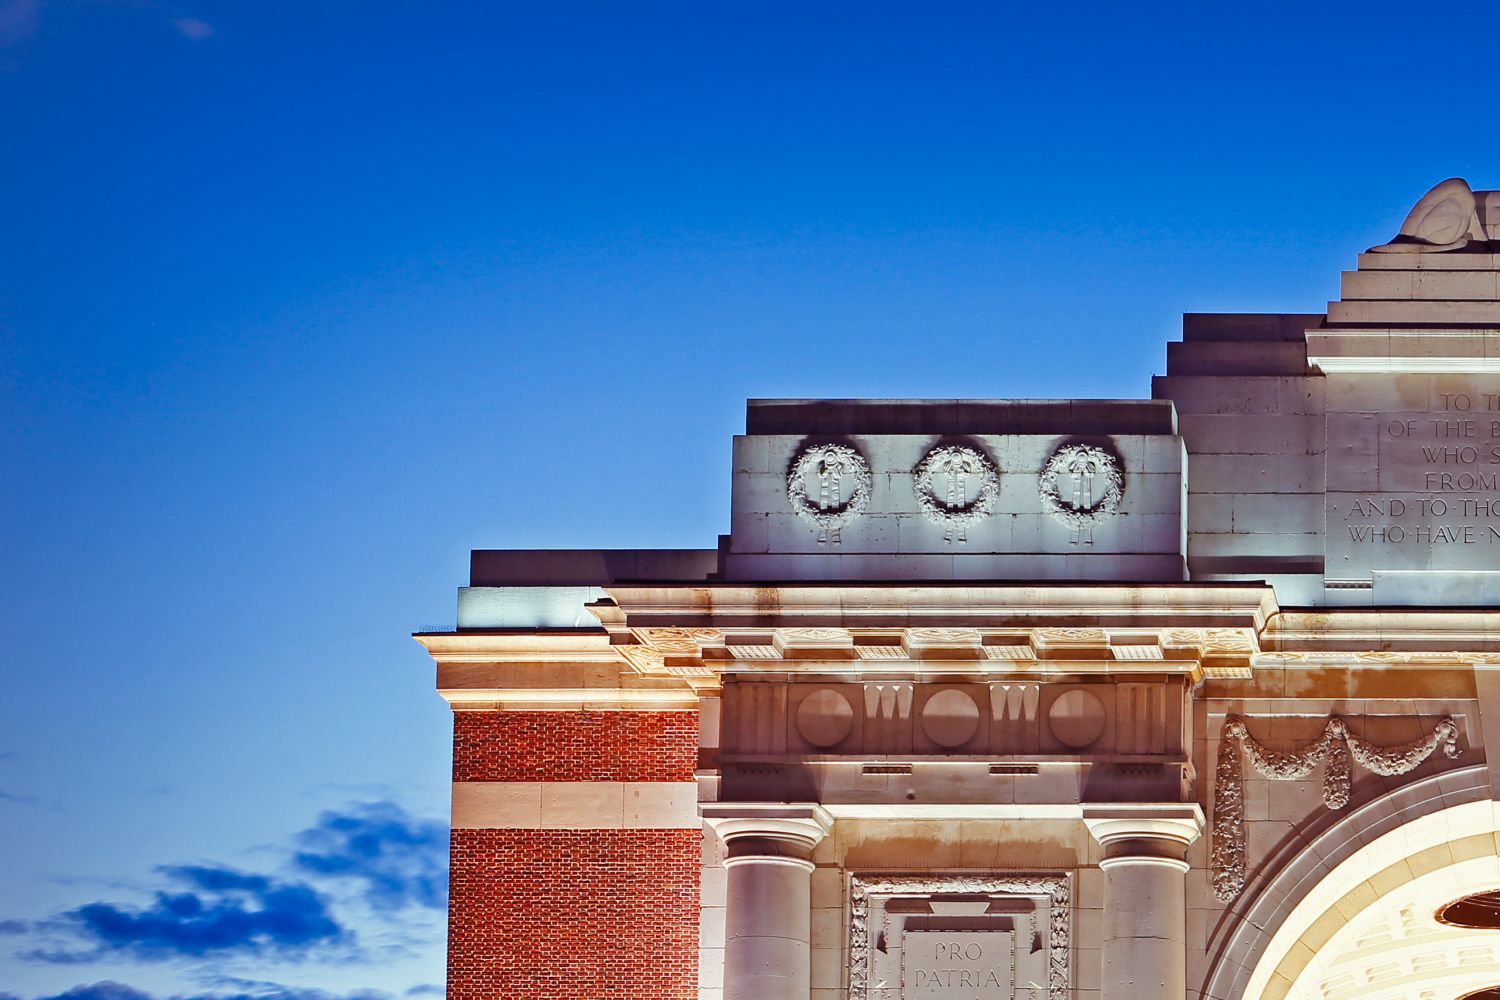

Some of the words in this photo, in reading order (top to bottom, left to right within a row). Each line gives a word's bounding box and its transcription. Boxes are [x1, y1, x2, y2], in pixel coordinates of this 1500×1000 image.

[1441, 394, 1471, 411] TO
[1387, 420, 1418, 437] OF
[1430, 420, 1476, 437] THE
[1423, 447, 1478, 464] WHO
[1425, 473, 1498, 491] FROM
[1349, 499, 1406, 517] AND
[1416, 499, 1448, 517] TO
[1348, 526, 1406, 543] WHO
[1416, 526, 1476, 543] HAVE
[935, 943, 982, 960] PRO
[915, 969, 1000, 987] PATRIA
